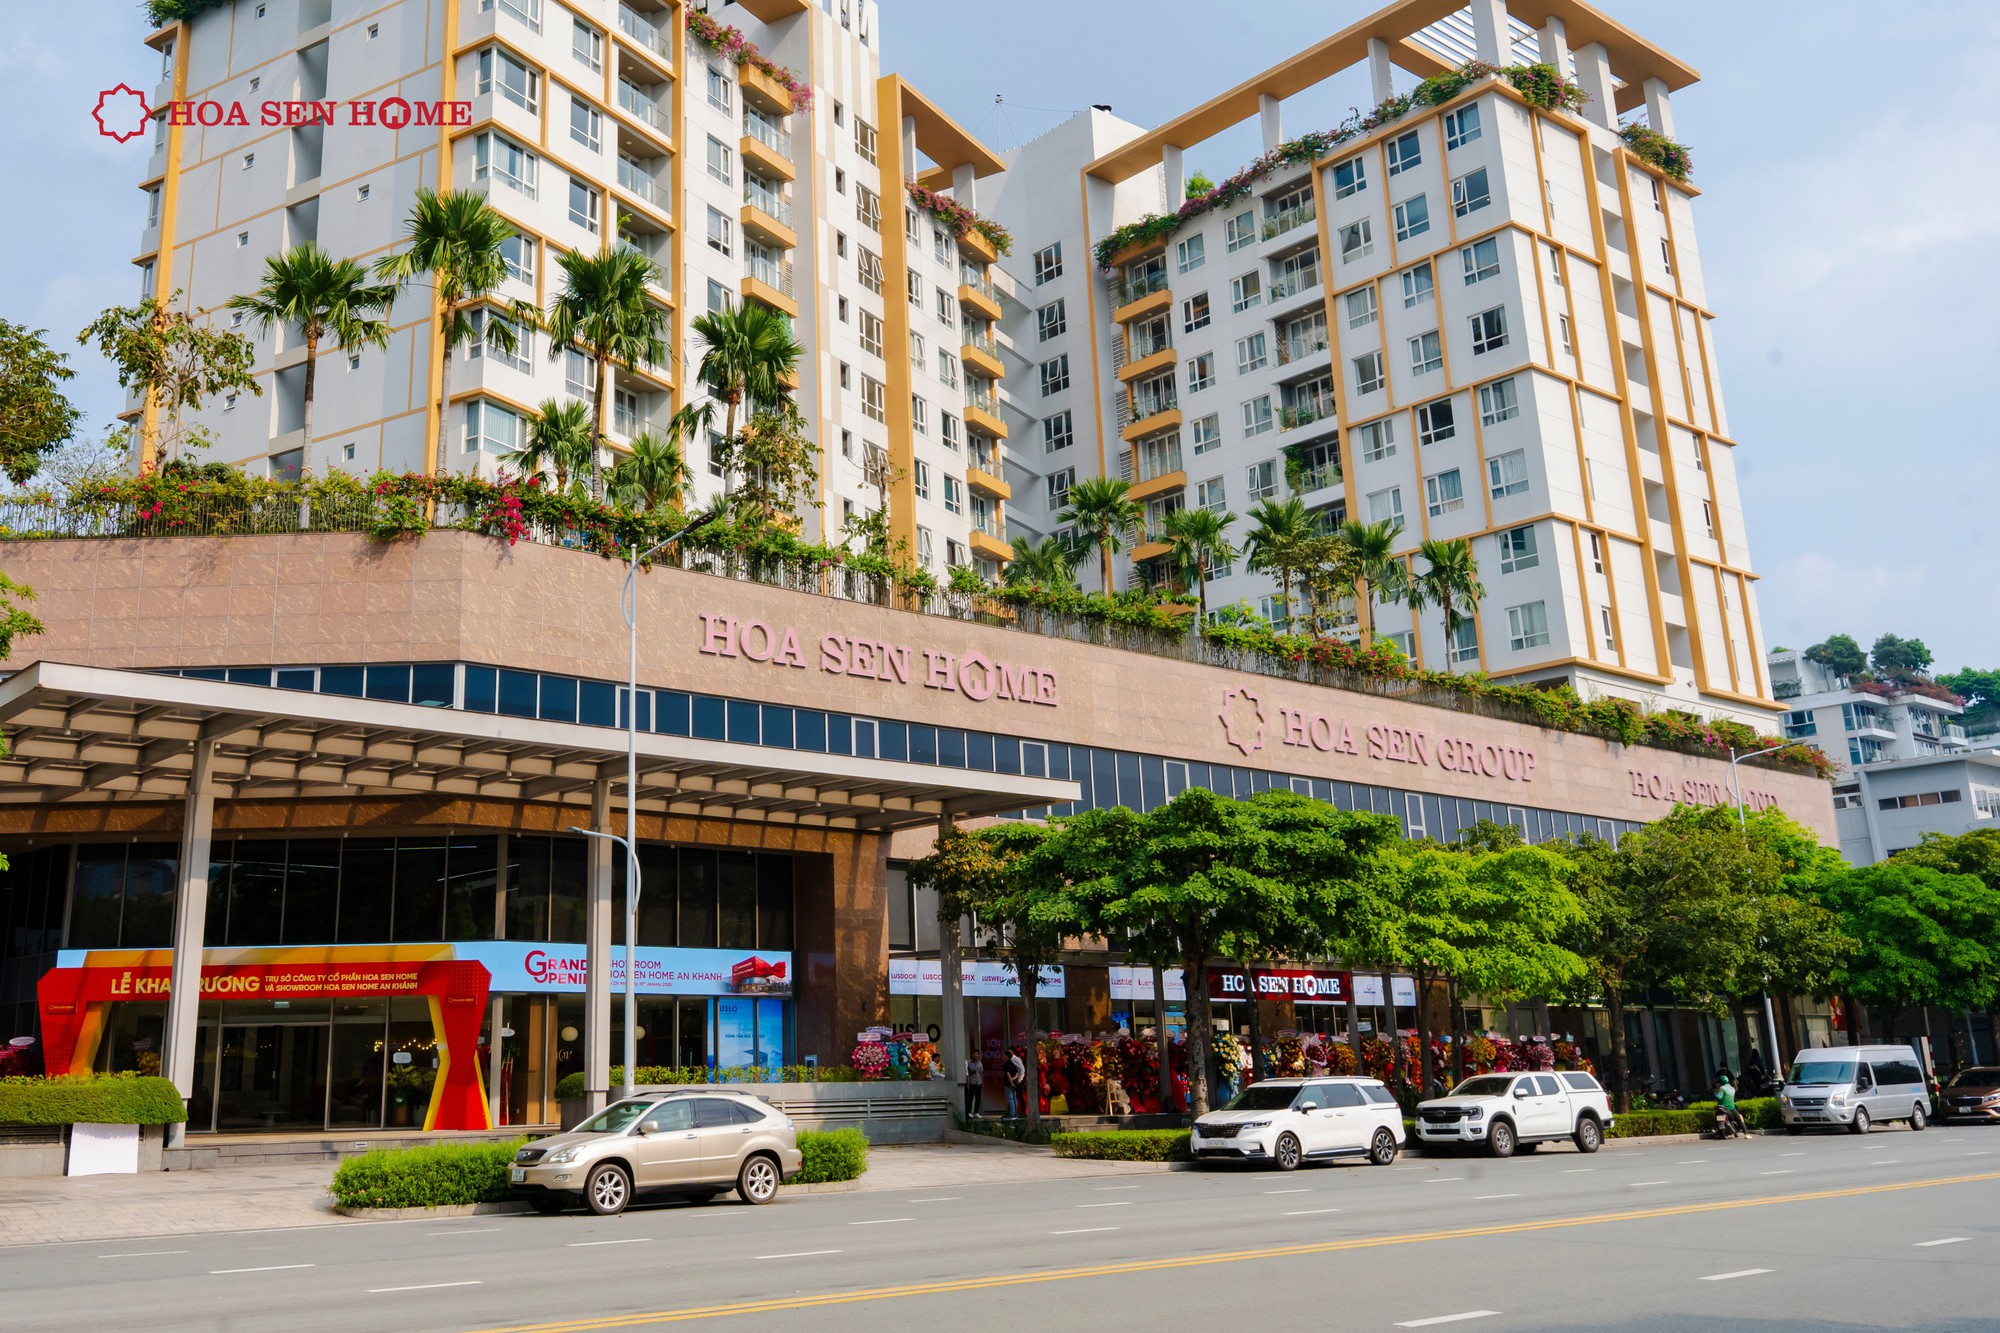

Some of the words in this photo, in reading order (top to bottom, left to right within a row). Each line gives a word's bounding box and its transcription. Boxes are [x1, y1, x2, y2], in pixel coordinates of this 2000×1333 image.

[700, 613, 807, 668] HOA
[819, 632, 912, 683] SEN
[923, 650, 1061, 707] HOME
[1281, 708, 1358, 755] HOA
[1366, 722, 1431, 766] SEN
[1436, 735, 1537, 782] GROUP
[1629, 769, 1678, 802] HOA
[1682, 779, 1722, 808] SEN
[1727, 785, 1779, 813] AND
[610, 960, 661, 969] HOROOM
[111, 971, 131, 994] LỄ
[135, 978, 172, 994] KHA
[199, 975, 260, 993] RƯƠNG
[265, 975, 279, 985] TRỤ
[293, 974, 316, 982] CÔNG
[328, 972, 340, 982] CỔ
[341, 972, 361, 981] PHẦN
[380, 973, 395, 981] SEN
[534, 973, 587, 985] OPENI
[634, 971, 646, 979] EN
[648, 971, 674, 980] HOME
[677, 972, 690, 980] AN
[692, 972, 722, 981] KHANH
[265, 982, 275, 992] VÀ
[276, 983, 322, 992] SHOWROOM
[323, 983, 341, 991] HOA
[341, 983, 355, 991] SEN
[380, 982, 391, 990] AN
[392, 981, 418, 990] KHÁNH
[1259, 975, 1289, 993] SEN
[1291, 974, 1340, 996] HOME
